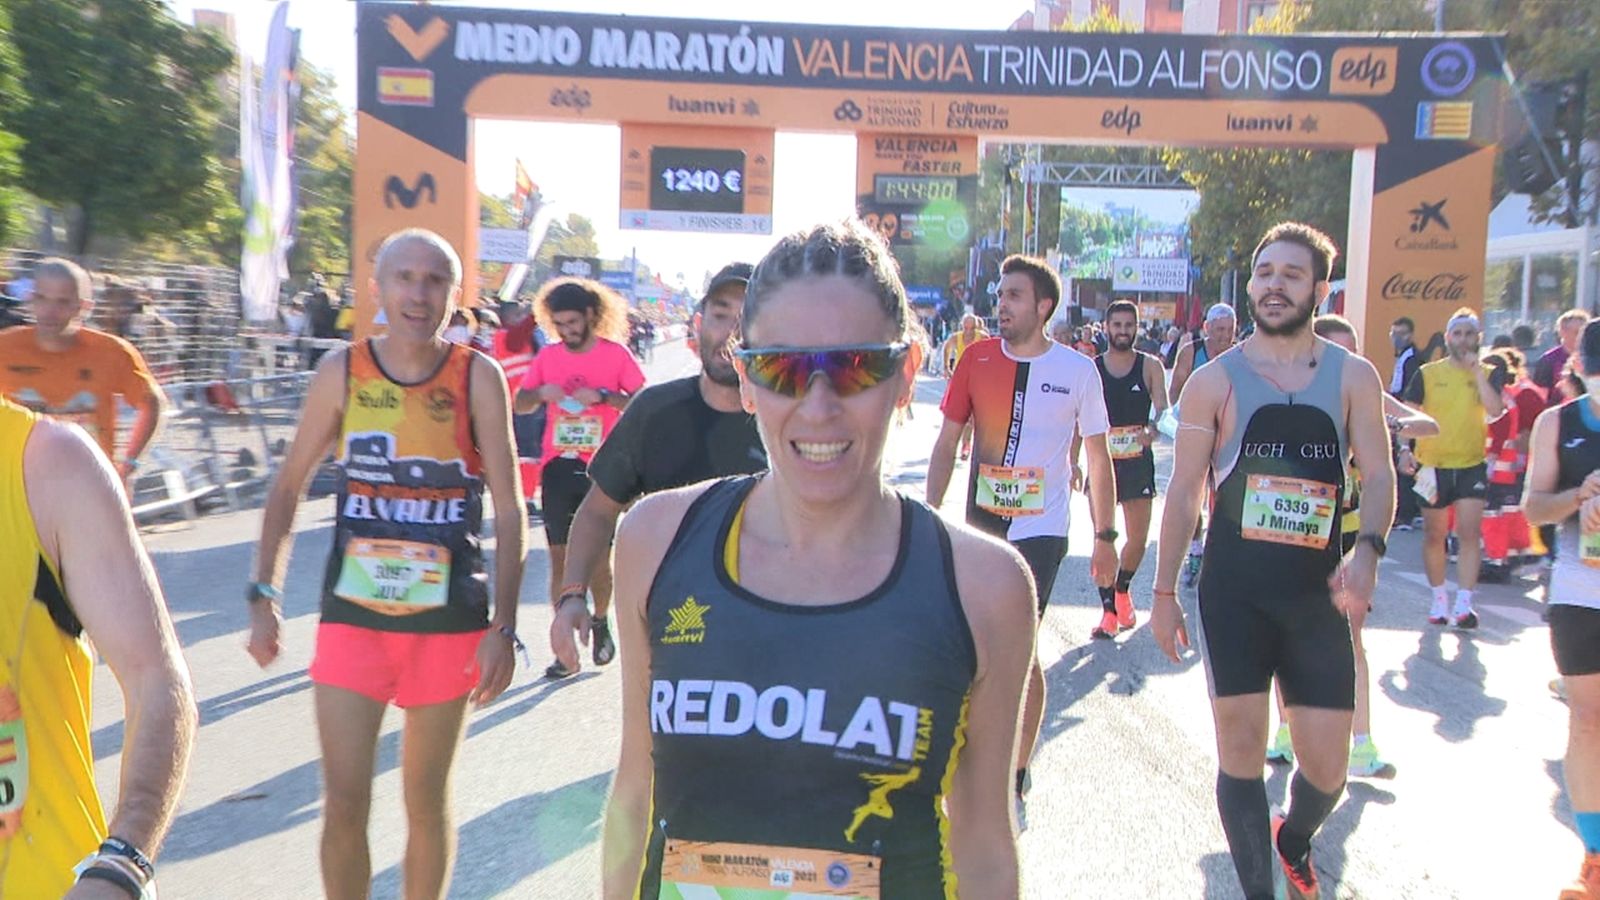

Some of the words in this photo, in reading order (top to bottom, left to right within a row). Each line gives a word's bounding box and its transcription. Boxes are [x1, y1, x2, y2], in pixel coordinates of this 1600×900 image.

[454, 20, 582, 66] MEDIO
[589, 23, 784, 76] MARATÓN
[793, 37, 973, 82] VALENCIA
[974, 44, 1144, 88] TRINIDAD
[1148, 48, 1322, 91] ALFONSO
[1339, 54, 1388, 88] edp
[667, 94, 736, 115] luanvi
[867, 107, 921, 117] TRINIDAD
[948, 100, 997, 117] Cultura
[867, 119, 921, 128] ALFONSO
[946, 116, 1009, 130] Esfuerzo
[1100, 106, 1142, 135] edp
[1227, 114, 1292, 131] luanvi
[875, 138, 958, 153] VALENCIA
[903, 161, 962, 173] FASTER
[662, 168, 720, 193] 1240
[723, 169, 742, 193] €
[1382, 272, 1470, 300] Coca-Cola
[1244, 443, 1285, 459] UCH
[1300, 443, 1336, 459] CEU
[994, 483, 1020, 495] 2911
[993, 495, 1022, 508] Pablo
[1274, 498, 1310, 515] 6339
[375, 497, 466, 525] VALLE
[1256, 513, 1266, 527] J
[1269, 515, 1319, 535] Minaya
[912, 707, 934, 761] TEAM
